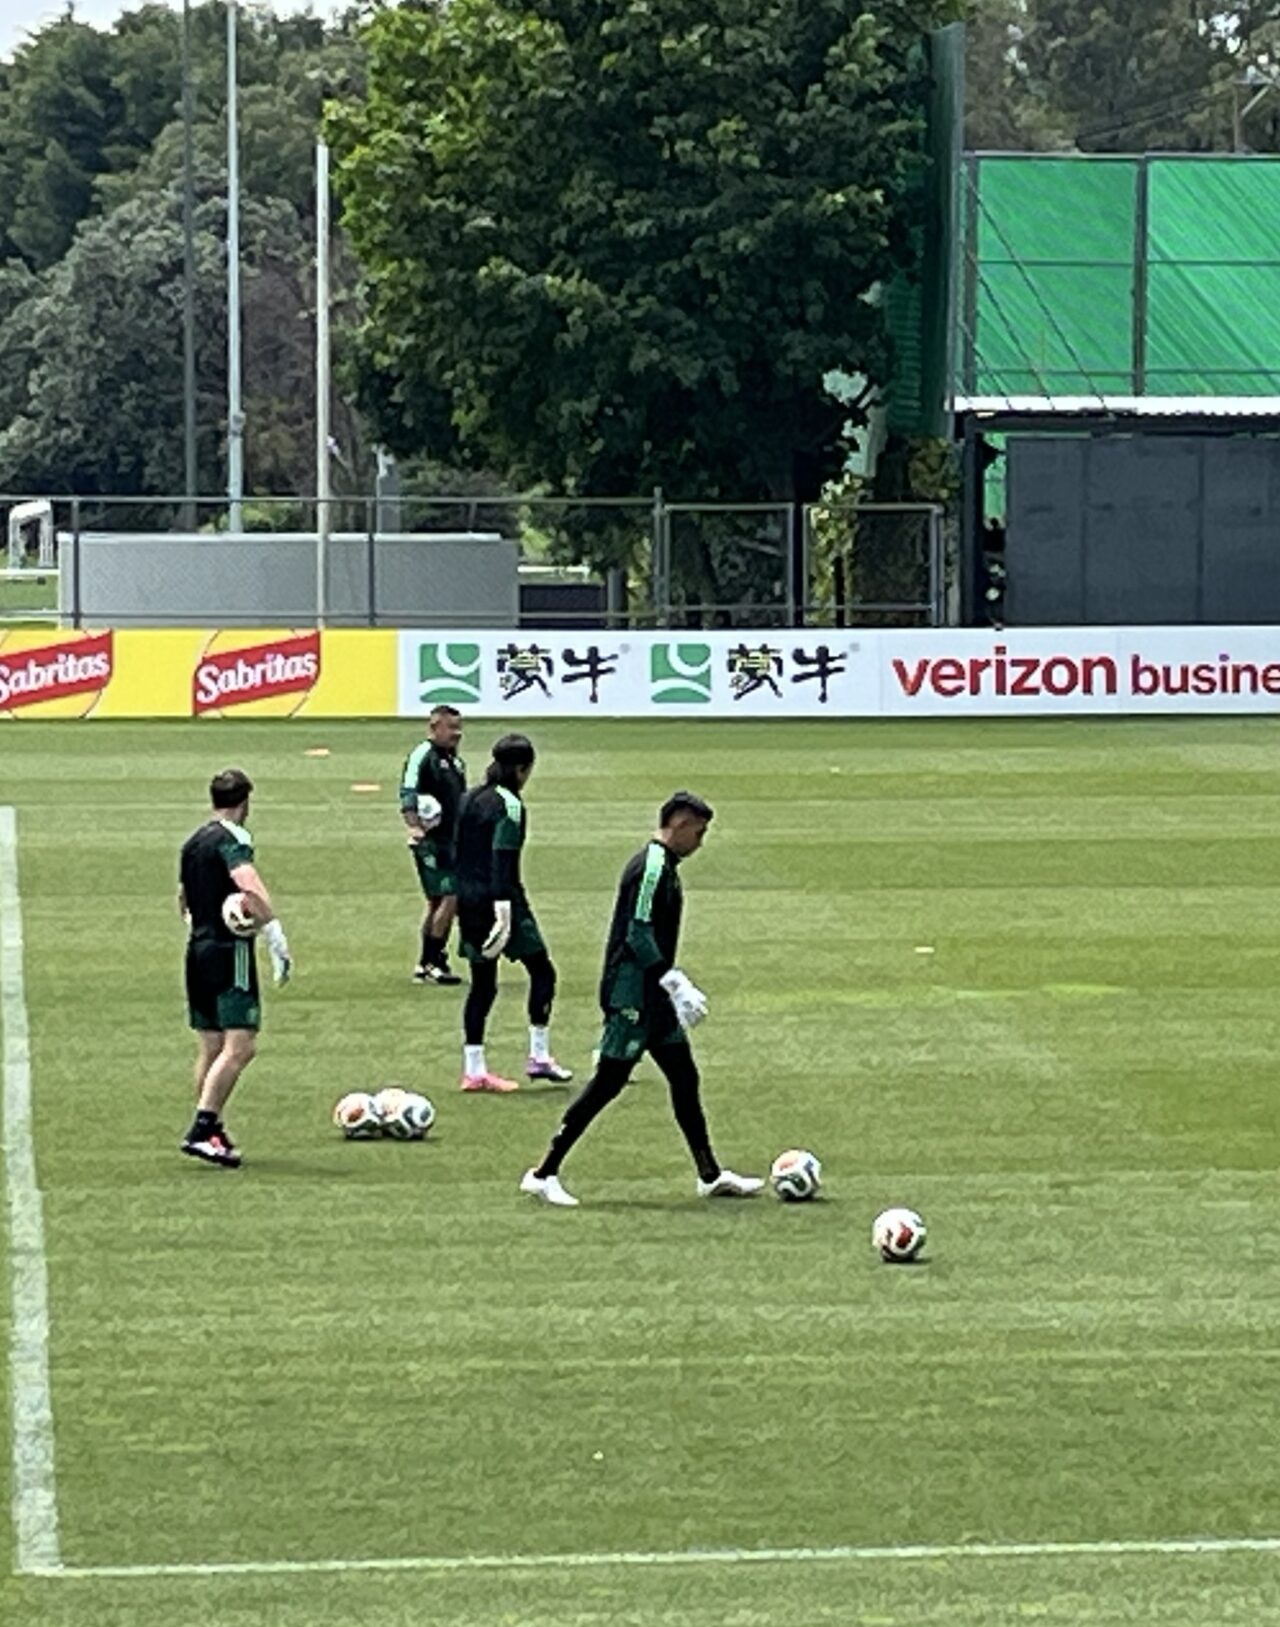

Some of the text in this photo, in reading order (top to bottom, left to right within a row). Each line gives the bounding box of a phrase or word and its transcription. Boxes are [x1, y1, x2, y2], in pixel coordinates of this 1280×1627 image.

[196, 652, 318, 704] Sabritas
[497, 643, 619, 703] 蒙牛
[727, 643, 848, 703] 蒙牛
[892, 646, 1118, 697] verizon
